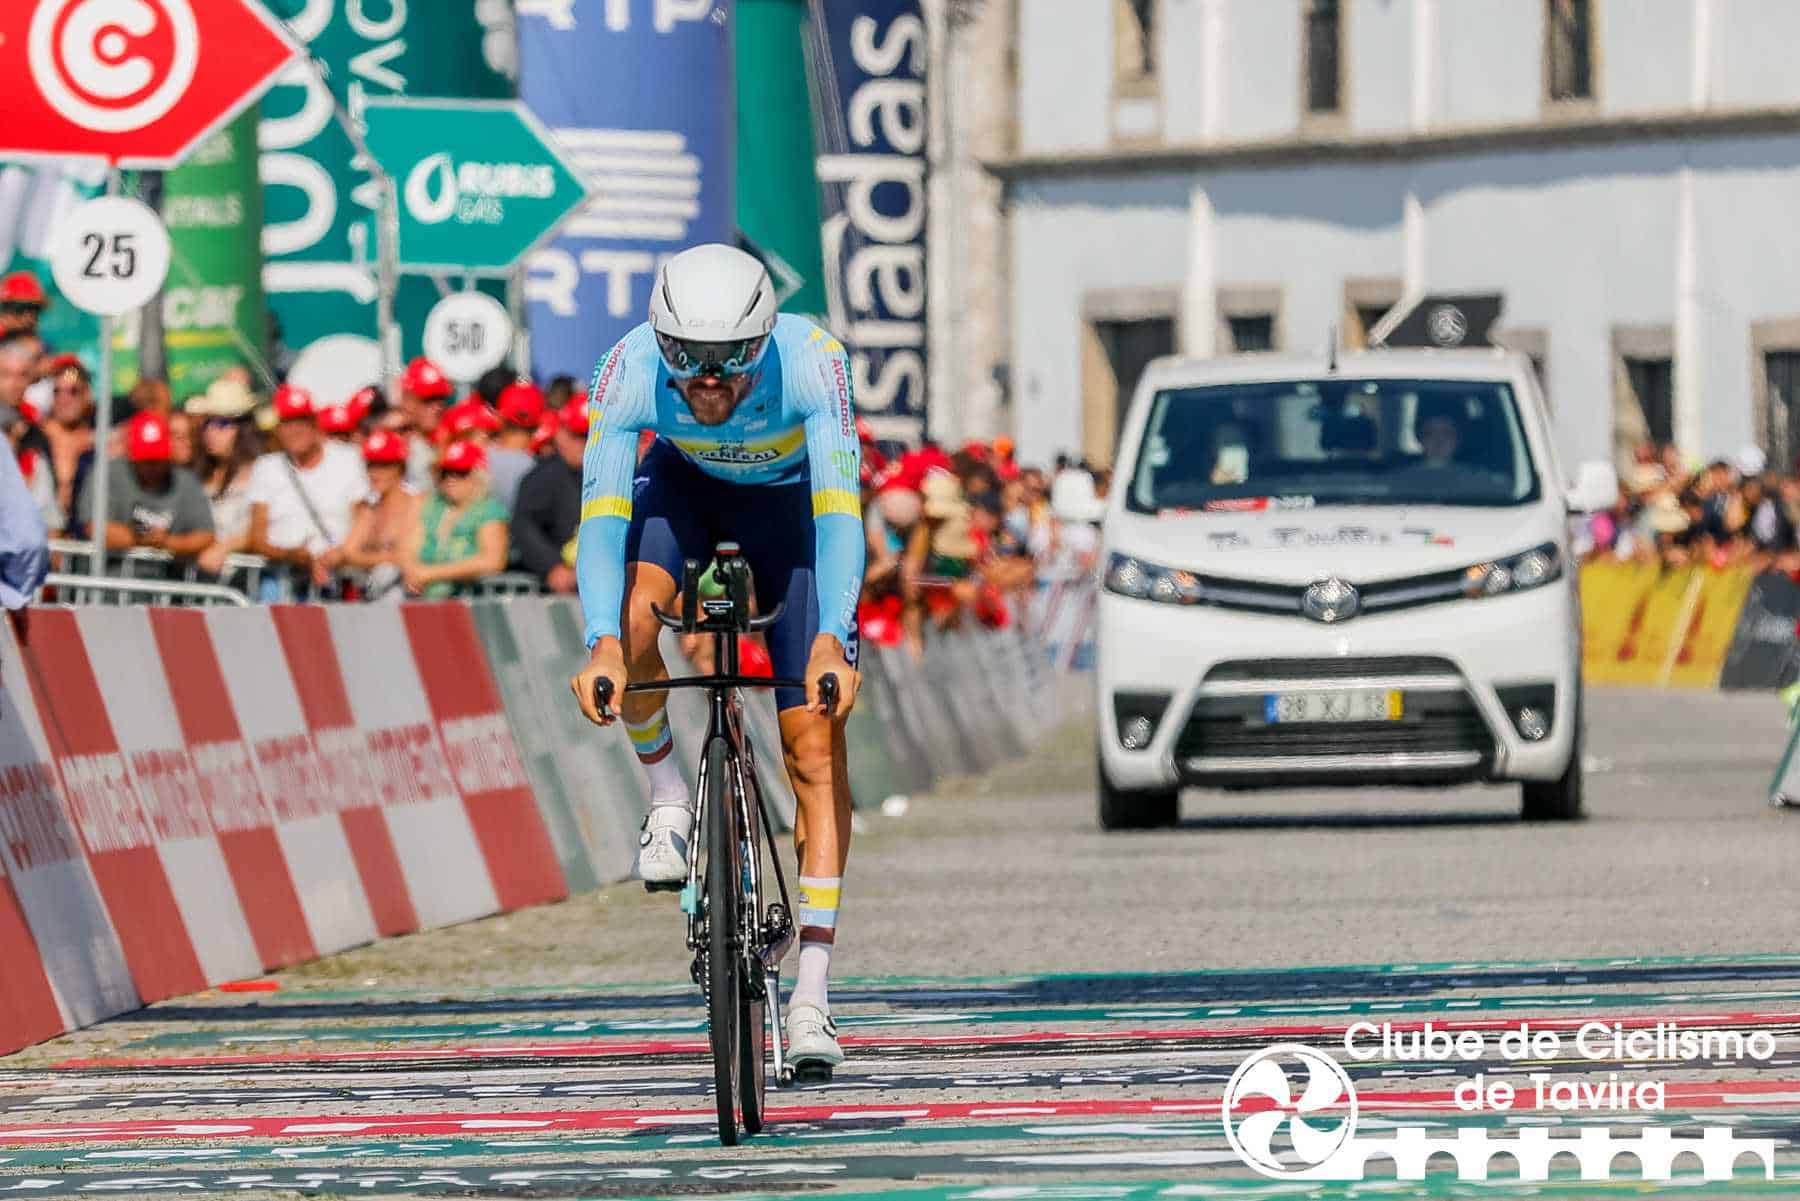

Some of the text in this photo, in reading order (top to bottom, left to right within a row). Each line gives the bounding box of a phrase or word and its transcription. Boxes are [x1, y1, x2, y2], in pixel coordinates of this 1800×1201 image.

[83, 233, 136, 279] 25
[521, 249, 676, 318] RT
[595, 341, 626, 404] AVOCADOS
[831, 358, 851, 438] AVOCADOS
